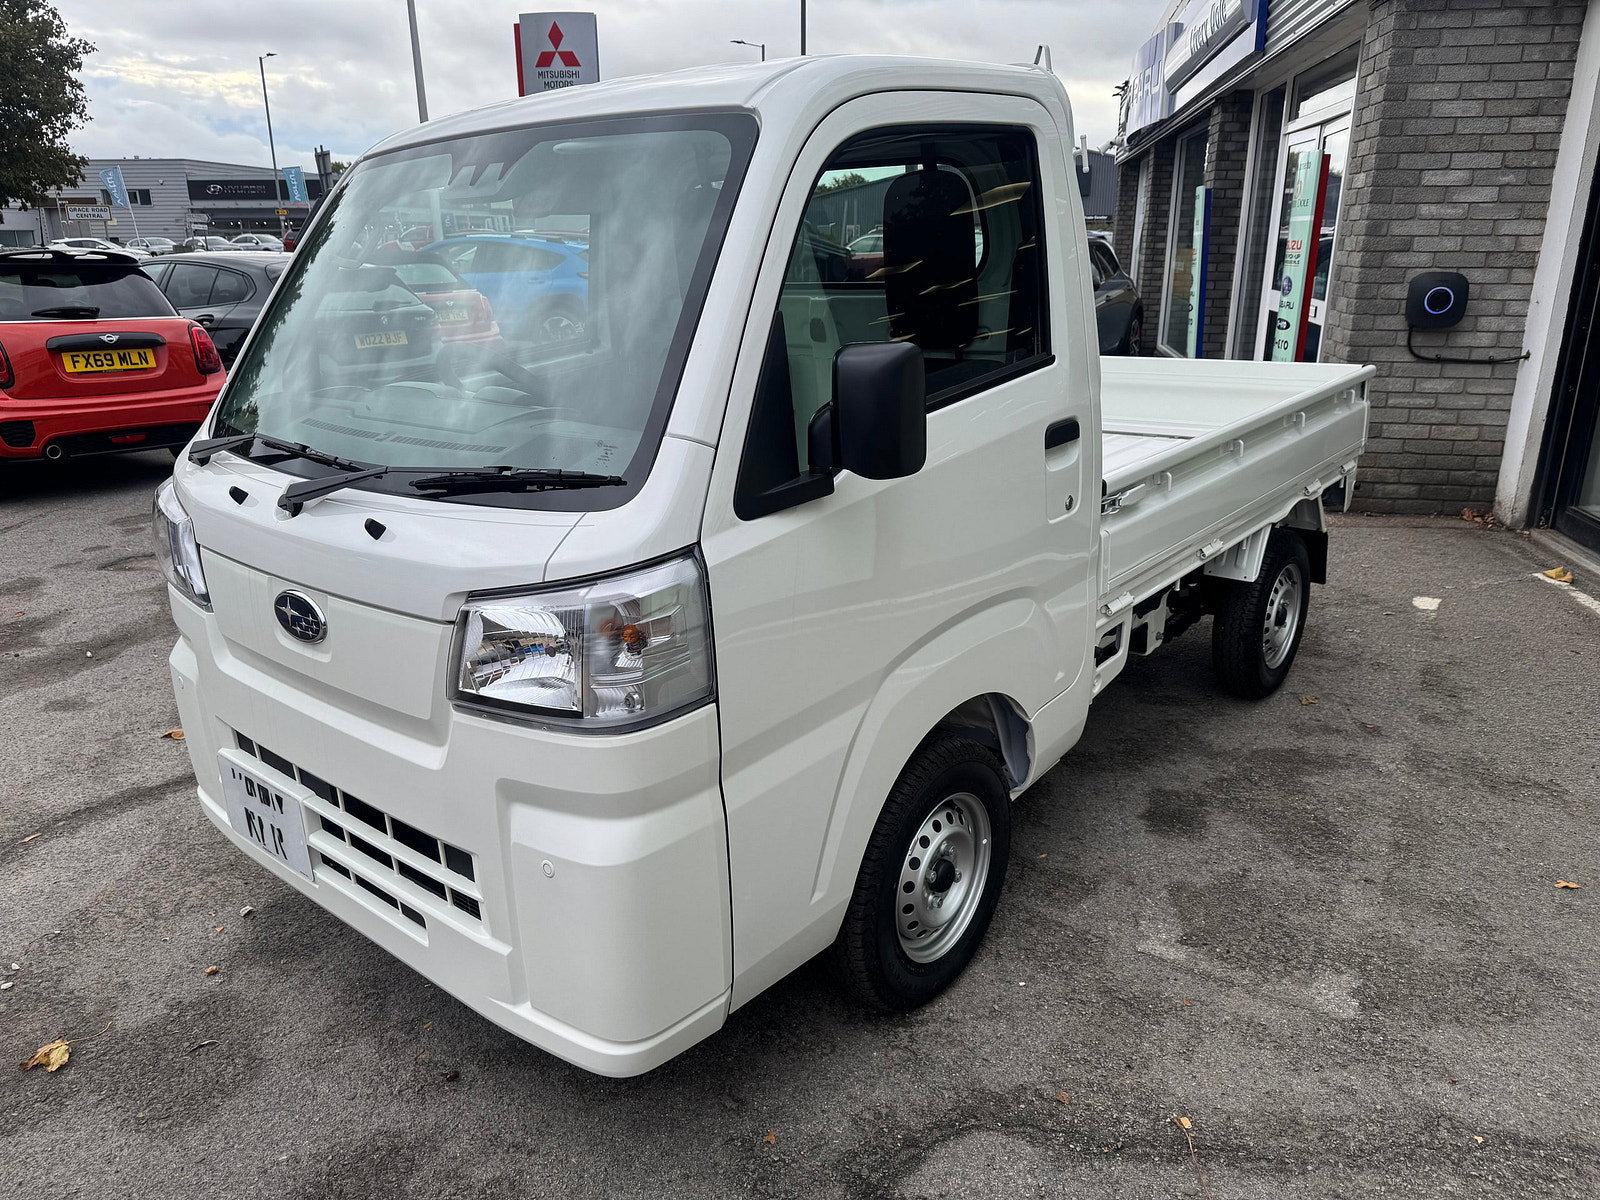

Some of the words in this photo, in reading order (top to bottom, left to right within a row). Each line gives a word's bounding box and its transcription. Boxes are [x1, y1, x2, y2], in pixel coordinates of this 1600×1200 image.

[537, 70, 580, 79] MITSUBISHI
[543, 80, 574, 90] MOTORS
[70, 353, 115, 369] FX69
[117, 351, 149, 367] MLN
